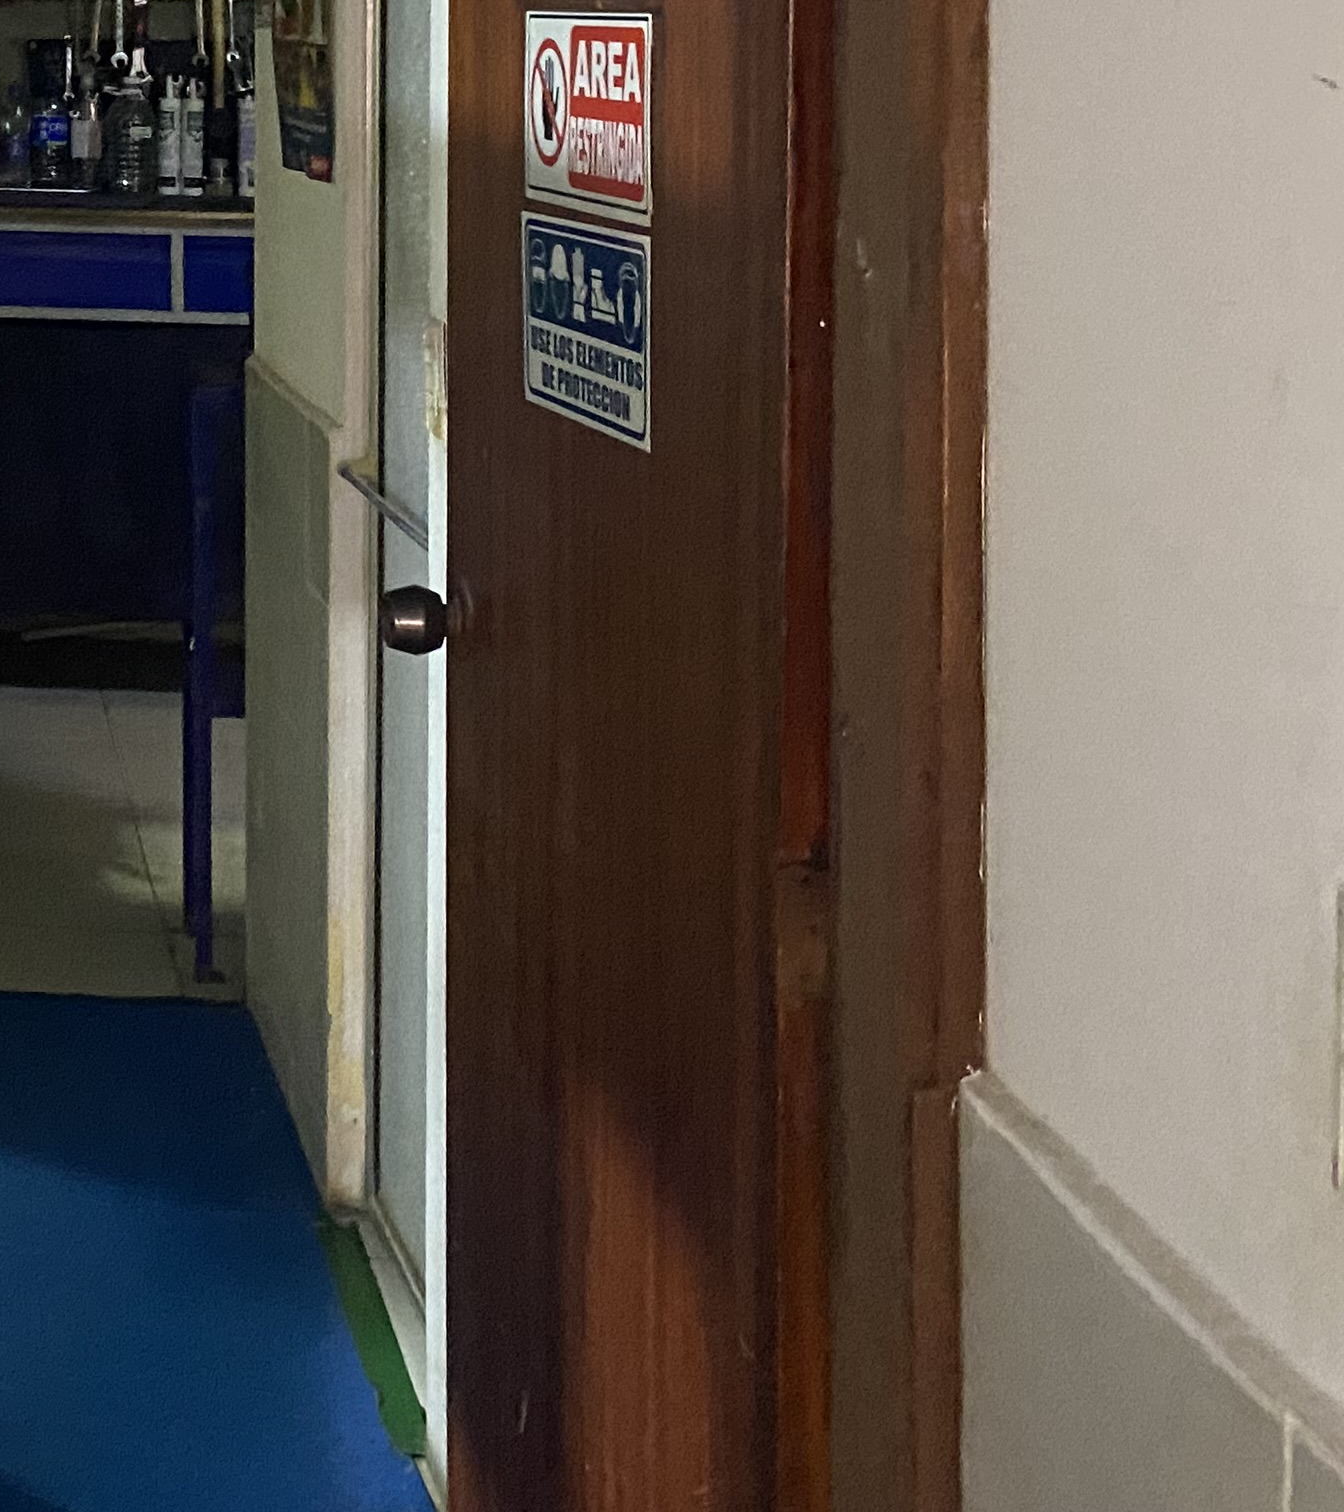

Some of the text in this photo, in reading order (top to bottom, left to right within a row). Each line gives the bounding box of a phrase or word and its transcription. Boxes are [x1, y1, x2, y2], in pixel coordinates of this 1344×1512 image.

[573, 39, 642, 103] AREA
[569, 115, 644, 186] RESTRINGIDA
[530, 324, 643, 391] USE LOS ELEMENTOS
[541, 361, 631, 422] DE PROTECCION
